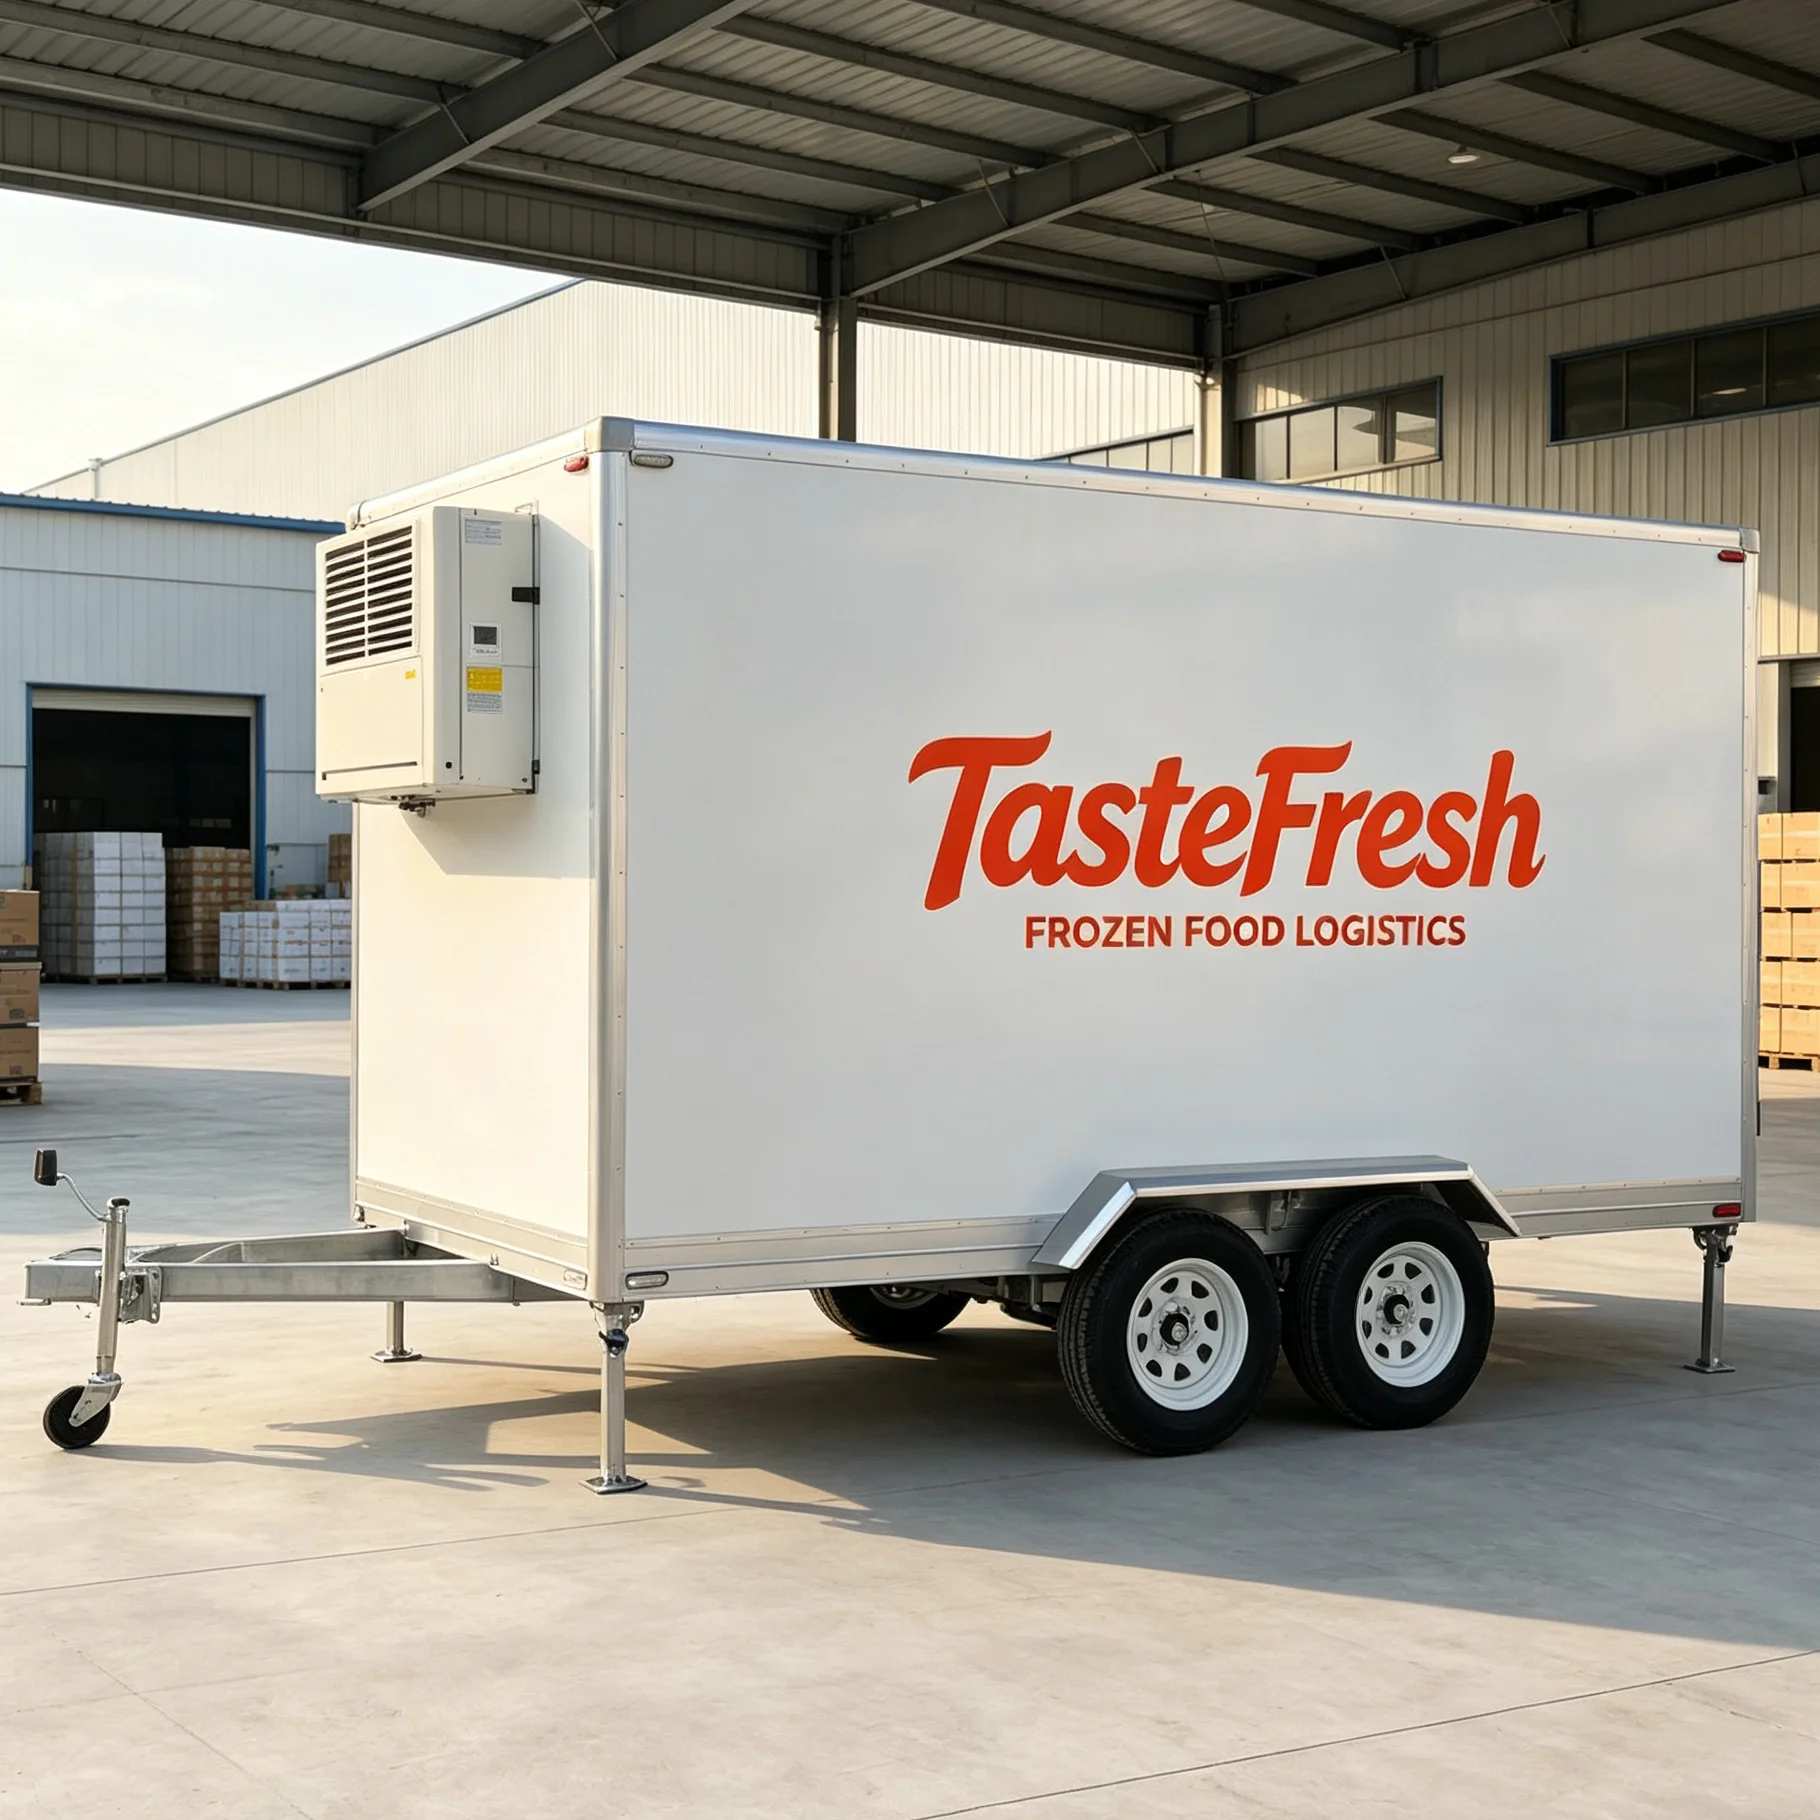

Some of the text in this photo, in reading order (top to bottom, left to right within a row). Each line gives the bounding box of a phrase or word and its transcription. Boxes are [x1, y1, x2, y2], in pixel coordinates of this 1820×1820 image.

[908, 730, 1546, 912] TasteFresh
[1026, 914, 1467, 949] FROZEN FOOD LOGISTICS
